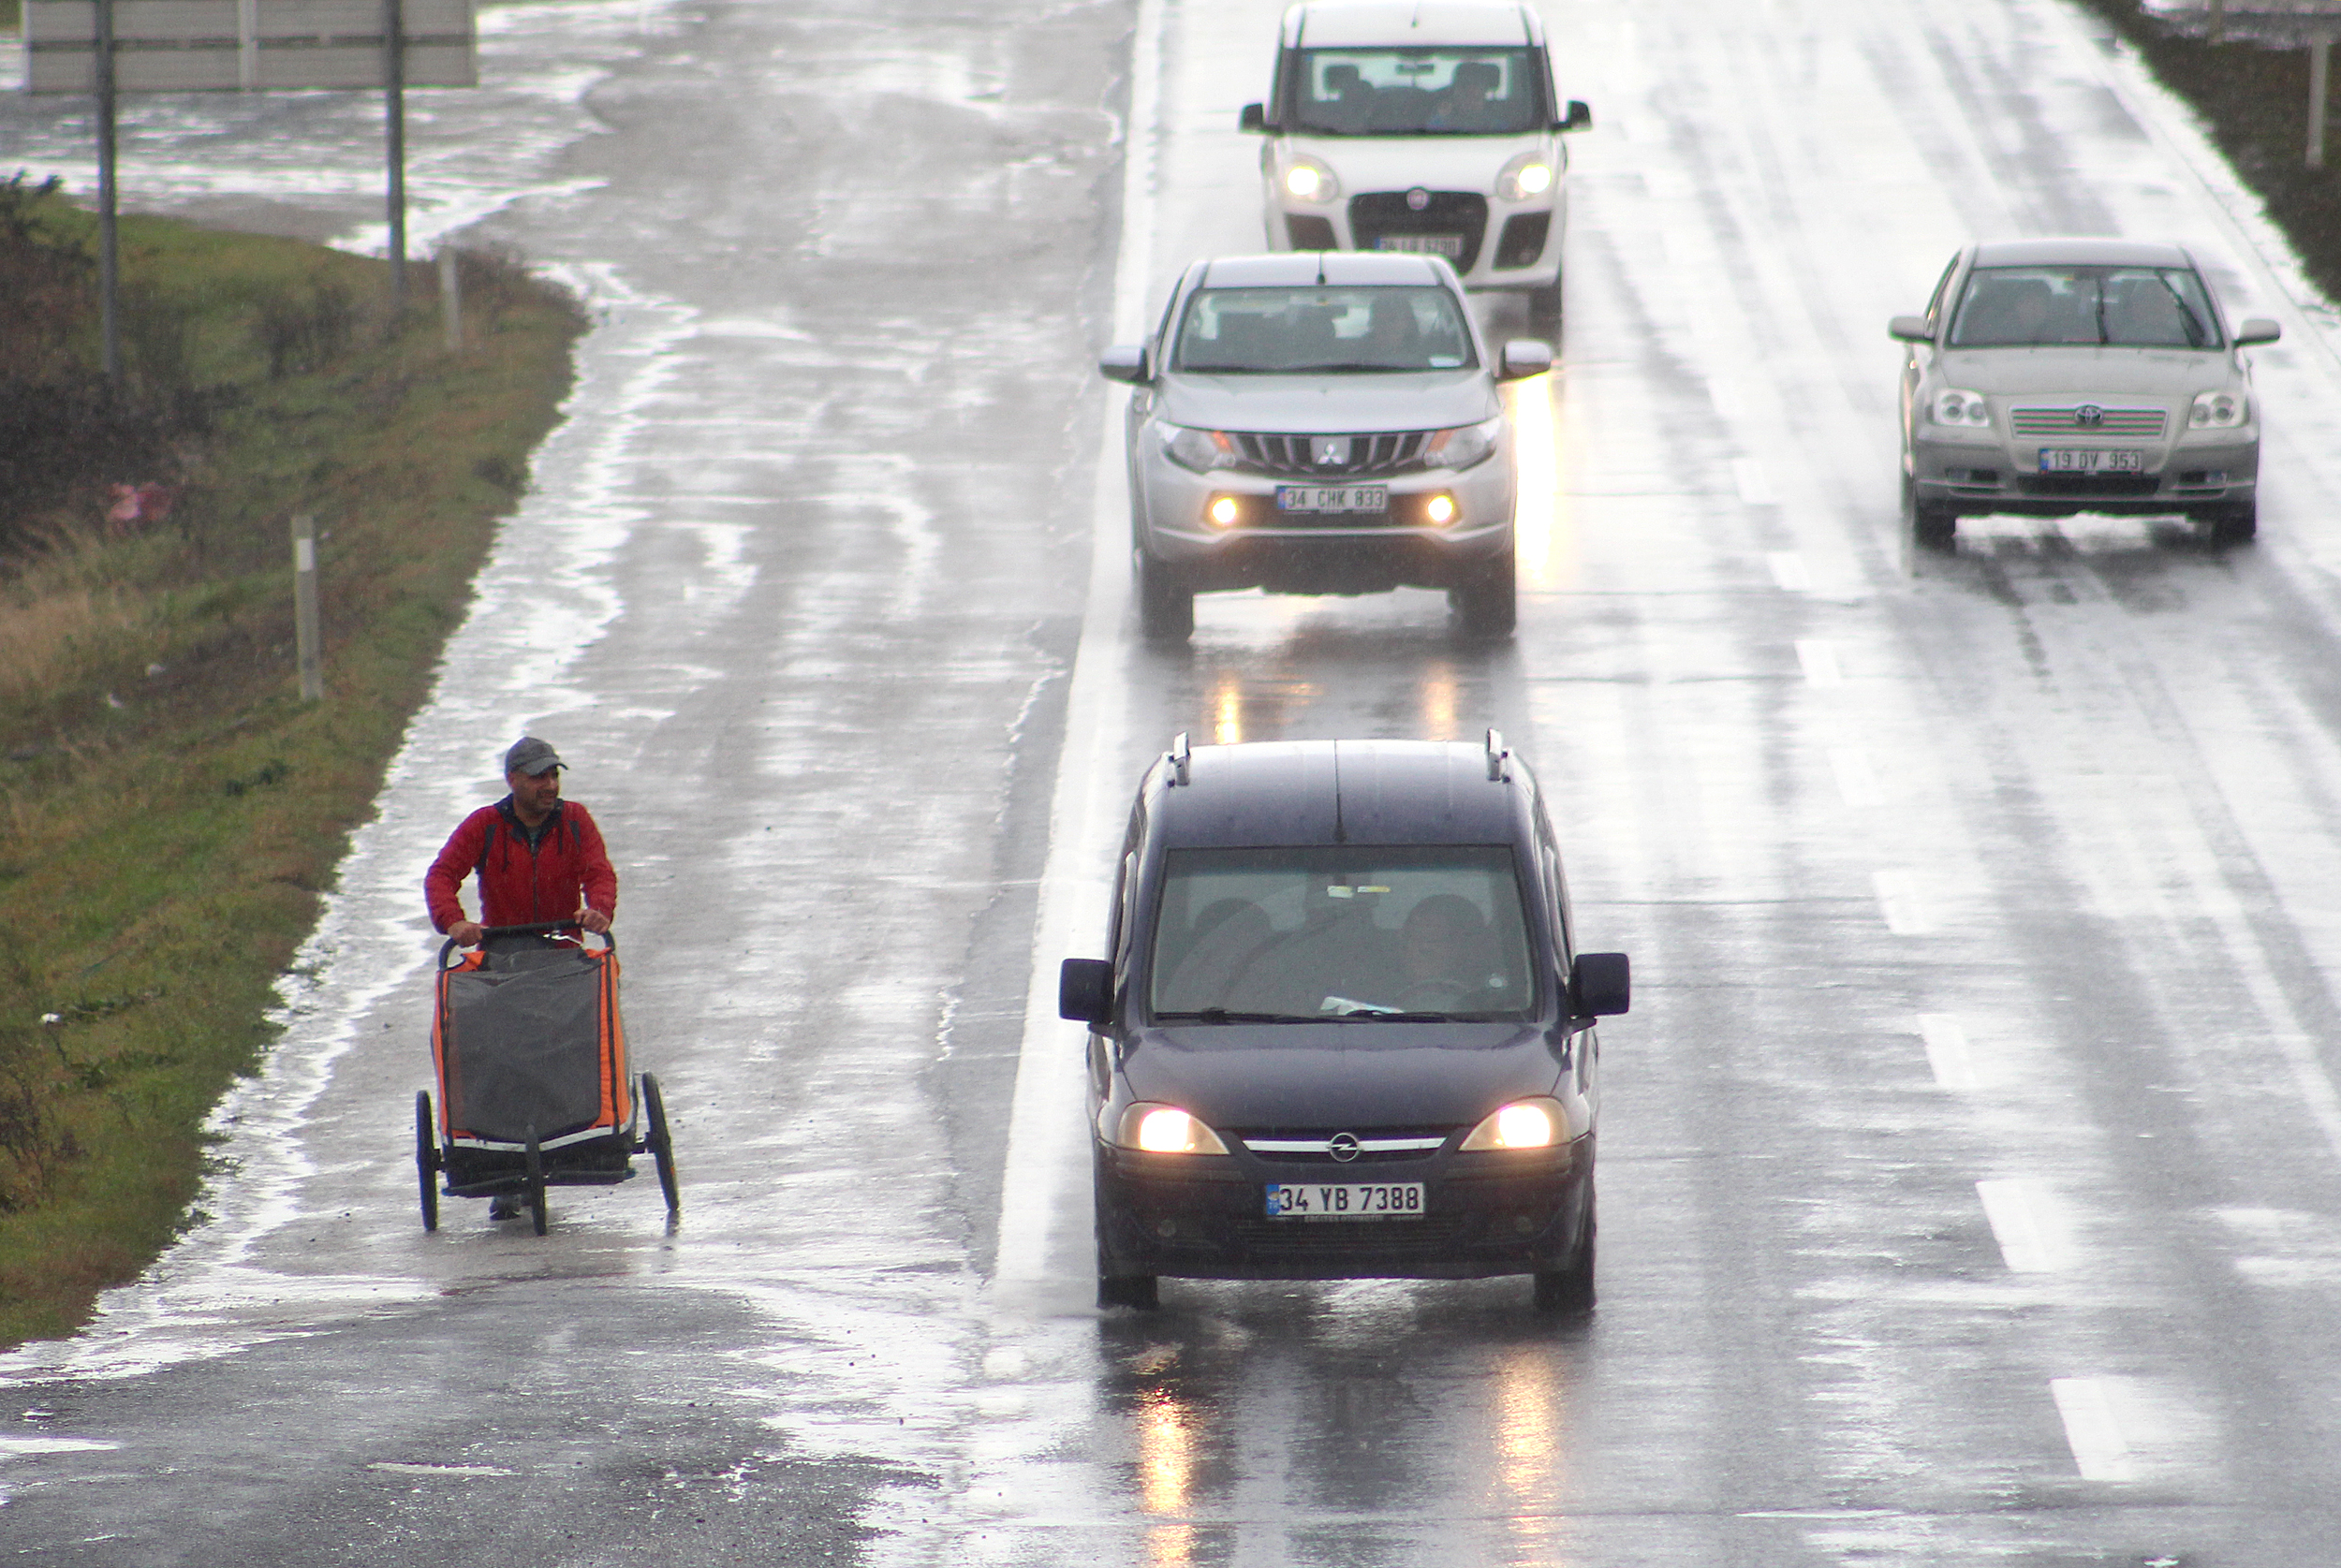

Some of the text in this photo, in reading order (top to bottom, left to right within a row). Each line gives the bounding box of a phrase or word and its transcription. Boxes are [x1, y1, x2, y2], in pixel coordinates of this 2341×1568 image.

[2054, 452, 2139, 469] 19 DV 953
[1288, 490, 1305, 506] 34
[1355, 490, 1383, 506] 833
[1280, 1187, 1419, 1211] 34 YB 7388
